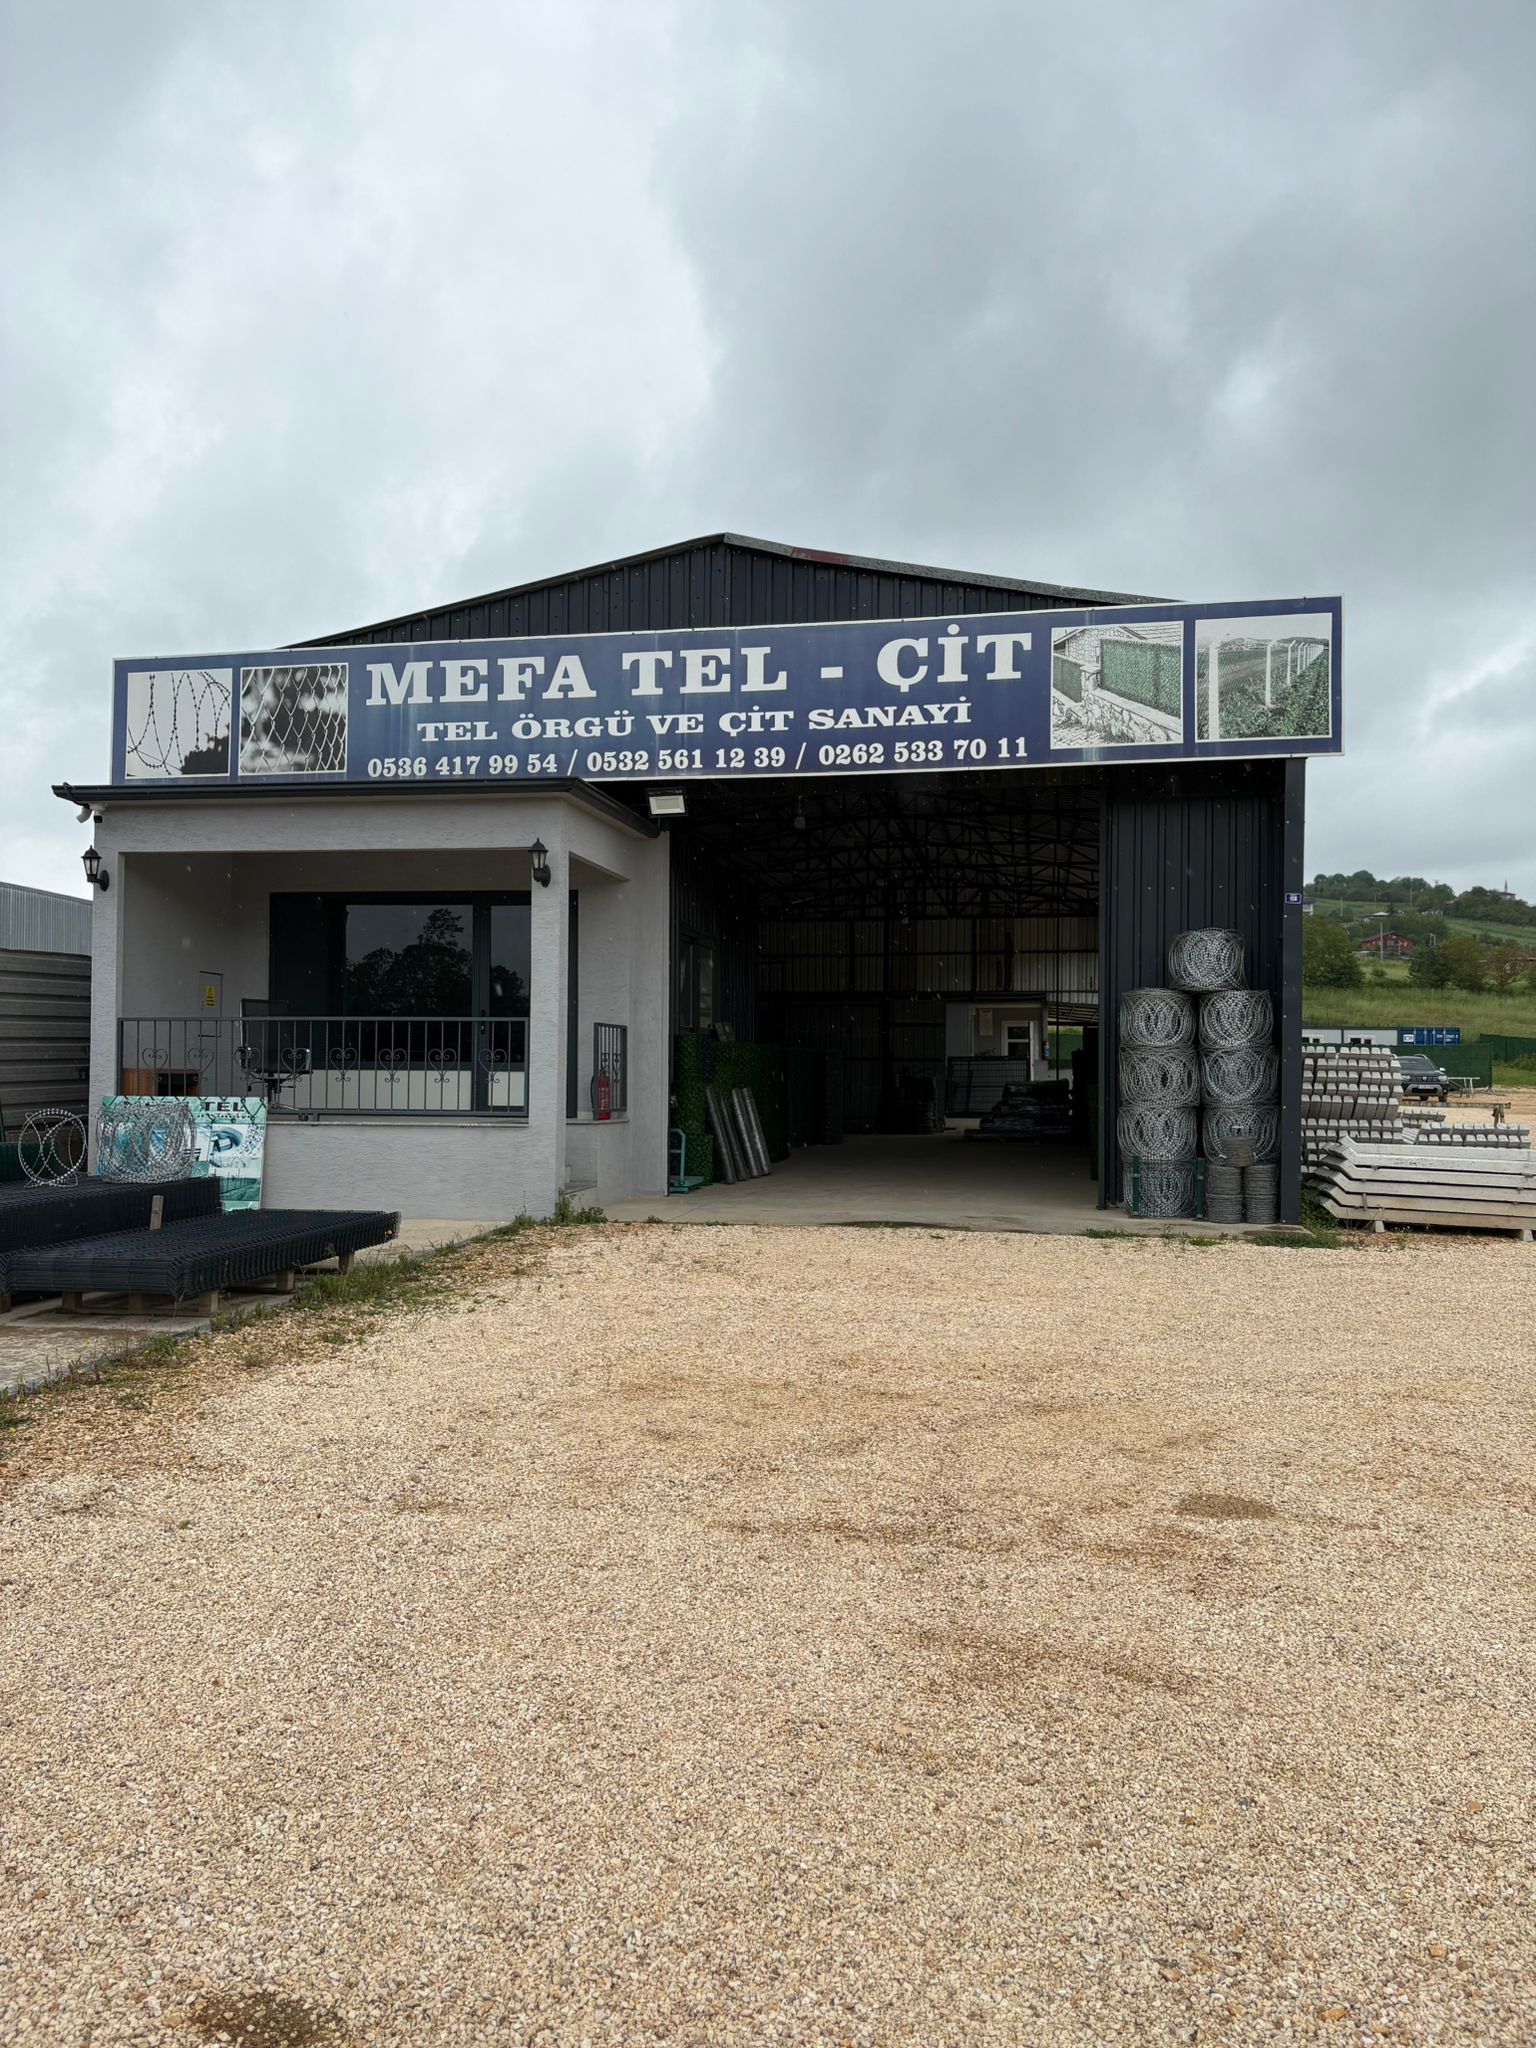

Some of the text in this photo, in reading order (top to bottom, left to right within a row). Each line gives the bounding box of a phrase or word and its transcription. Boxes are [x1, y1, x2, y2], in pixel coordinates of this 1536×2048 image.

[366, 655, 597, 706] MEFA
[621, 647, 788, 697] TEL
[876, 623, 1033, 693] ÇİT
[417, 696, 972, 742] TEL ÖRGÜ VE ÇİT SANAYİ
[367, 736, 1028, 780] 0536 417 99 54 / 0532 561 12 39 / 0262 533 70 11
[202, 1101, 245, 1112] TEL
